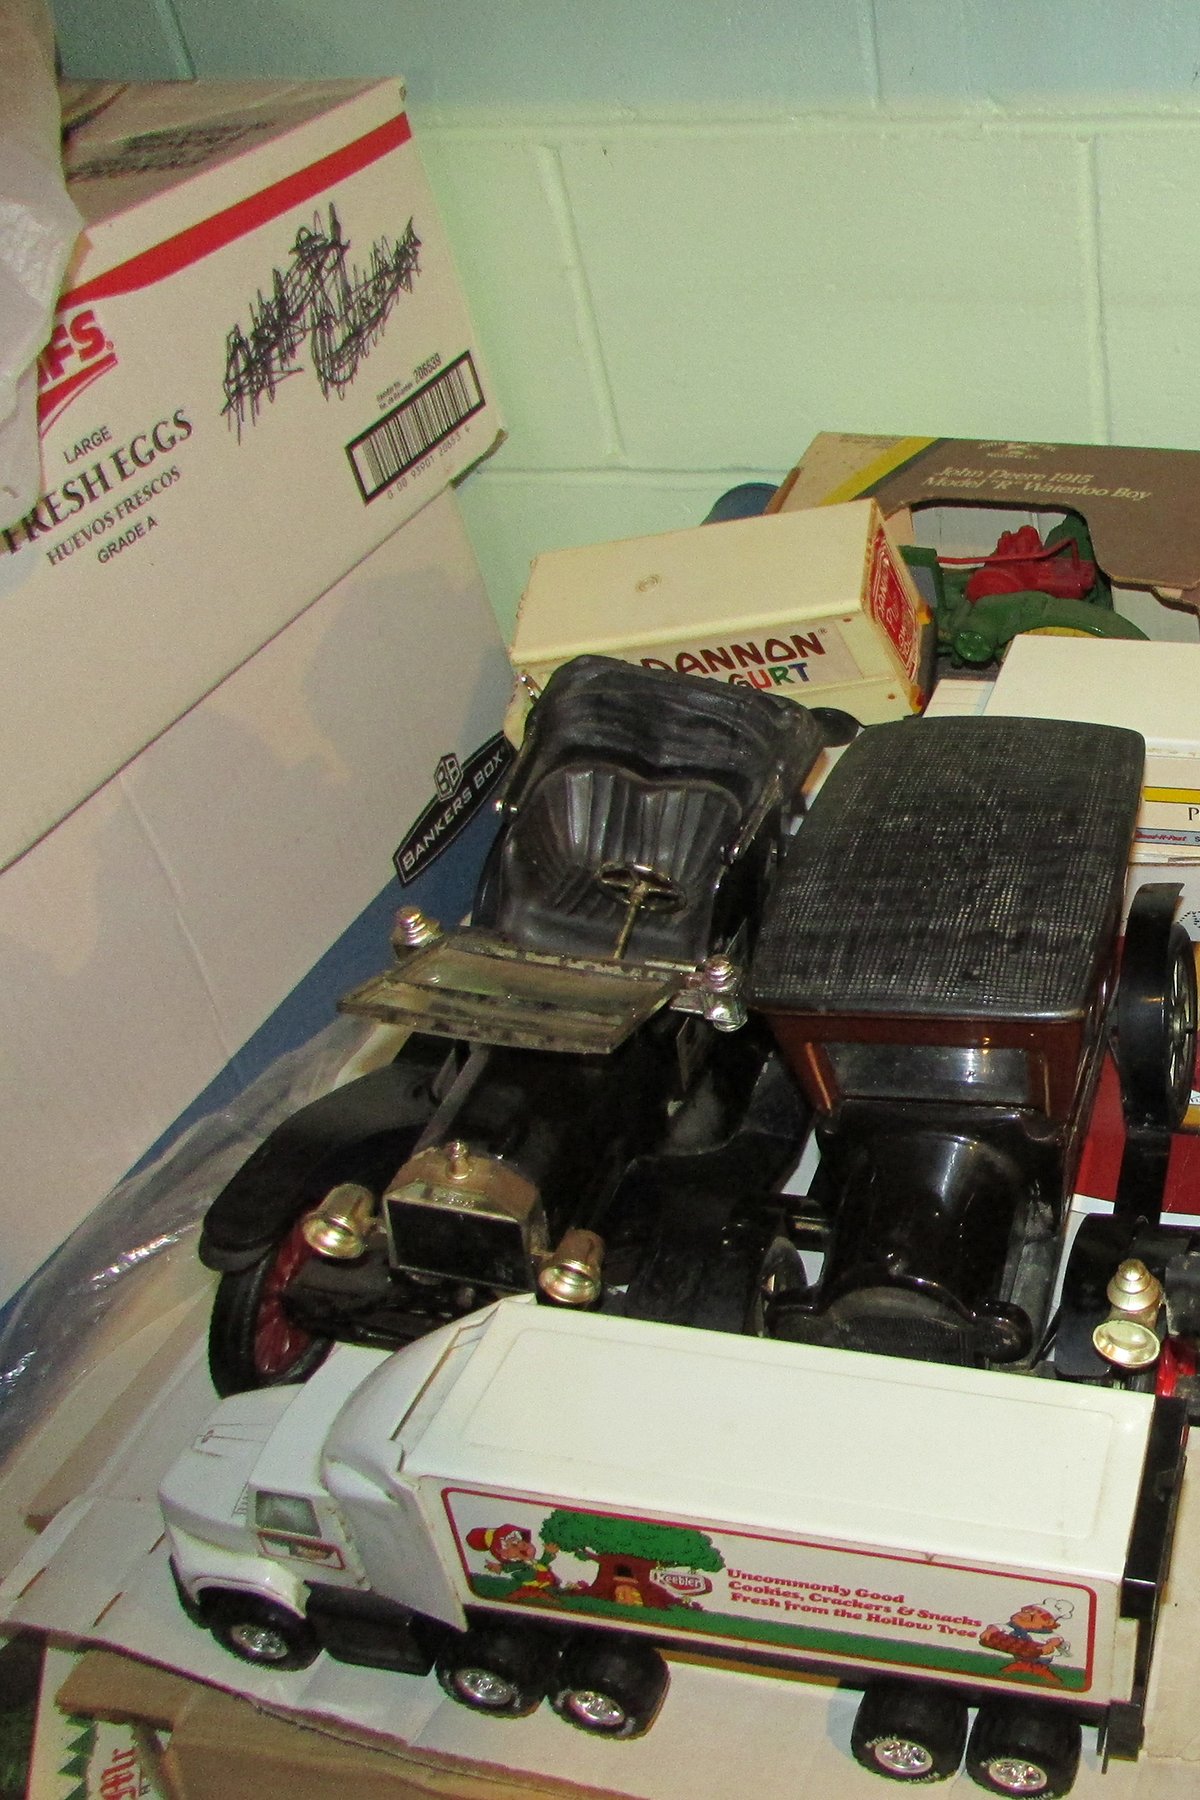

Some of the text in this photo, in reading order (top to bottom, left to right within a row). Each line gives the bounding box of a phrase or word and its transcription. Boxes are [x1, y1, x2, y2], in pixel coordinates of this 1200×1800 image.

[38, 309, 106, 388] FS
[63, 425, 113, 464] LARGE
[109, 408, 193, 482] EGGS
[922, 476, 986, 489] Model
[1024, 481, 1109, 497] Waterloo
[1111, 487, 1152, 502] Boy
[936, 466, 1095, 484] John Deere 1915
[46, 465, 181, 566] HUEVOS FRESCOS
[98, 515, 158, 564] GRADE A
[728, 662, 810, 690] GURT
[402, 750, 503, 872] BANKERS BOX
[659, 1573, 702, 1588] Keebler
[727, 1568, 905, 1603] Uncommonly Good
[728, 1580, 982, 1627] Cookies, Crackers & Snacks
[731, 1592, 978, 1638] Fresh from the Hollow Tree
